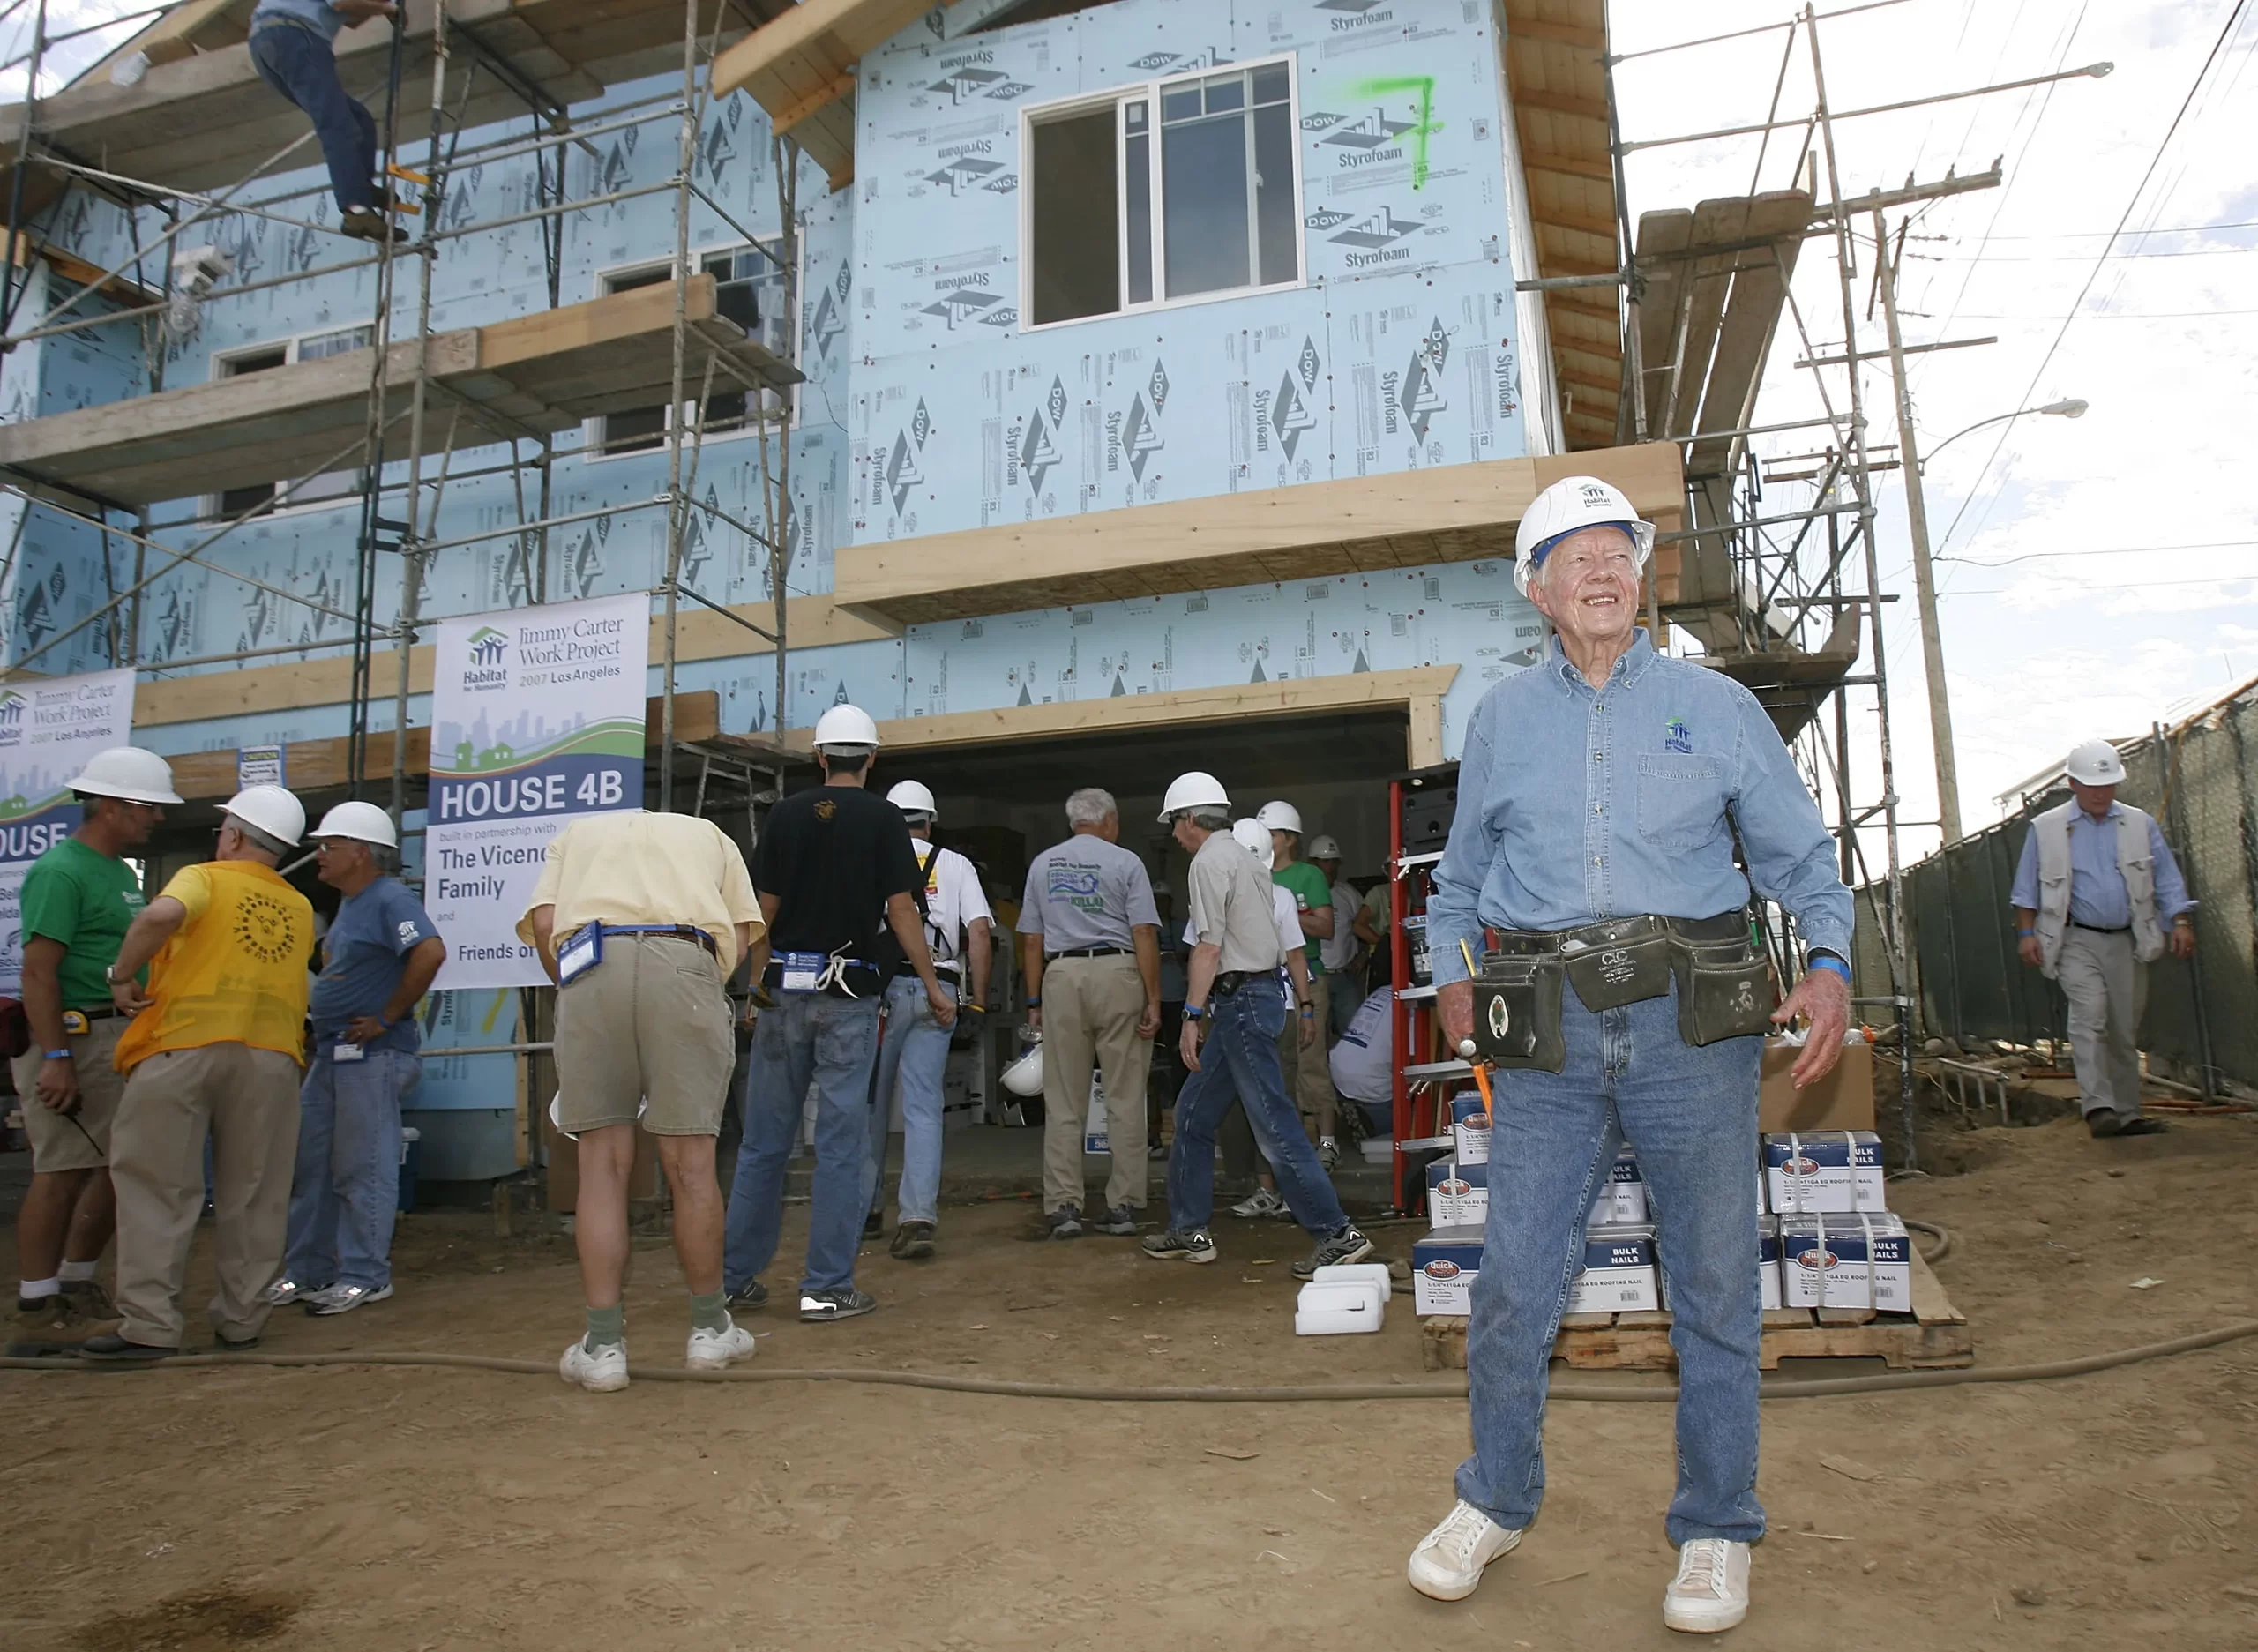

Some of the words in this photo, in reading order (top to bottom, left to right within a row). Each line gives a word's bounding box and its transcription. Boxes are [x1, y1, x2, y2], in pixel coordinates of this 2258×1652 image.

[1331, 10, 1393, 31] Styrofoam
[940, 49, 994, 70] Styrofoam
[938, 139, 992, 160] Styrofoam
[1338, 146, 1402, 168] Styrofoam
[1345, 246, 1409, 268] Styrofoam
[934, 272, 990, 292] Styrofoam
[1383, 370, 1399, 434] Styrofoam
[1253, 389, 1270, 452] Styrofoam
[1107, 410, 1122, 472] Styrofoam
[1006, 426, 1021, 487] Styrofoam
[871, 446, 887, 505] Styrofoam
[519, 625, 571, 648] Jimmy
[573, 618, 624, 639] Carter
[519, 647, 563, 666] Work
[568, 639, 621, 663] Project
[464, 669, 508, 684] Habitat
[519, 673, 548, 687] 2007
[550, 671, 572, 684] Los
[572, 665, 621, 682] Angeles
[441, 774, 566, 819] HOUSE
[576, 769, 624, 806] 4B
[0, 822, 68, 859] USE
[439, 830, 461, 842] built
[463, 829, 473, 840] in
[475, 824, 531, 840] partnership
[535, 822, 557, 833] with
[439, 849, 476, 870] The
[438, 876, 505, 901] Family
[437, 911, 455, 922] and
[459, 944, 513, 961] Friends
[1611, 1255, 1640, 1264] NAILS
[1612, 1246, 1639, 1256] BULK
